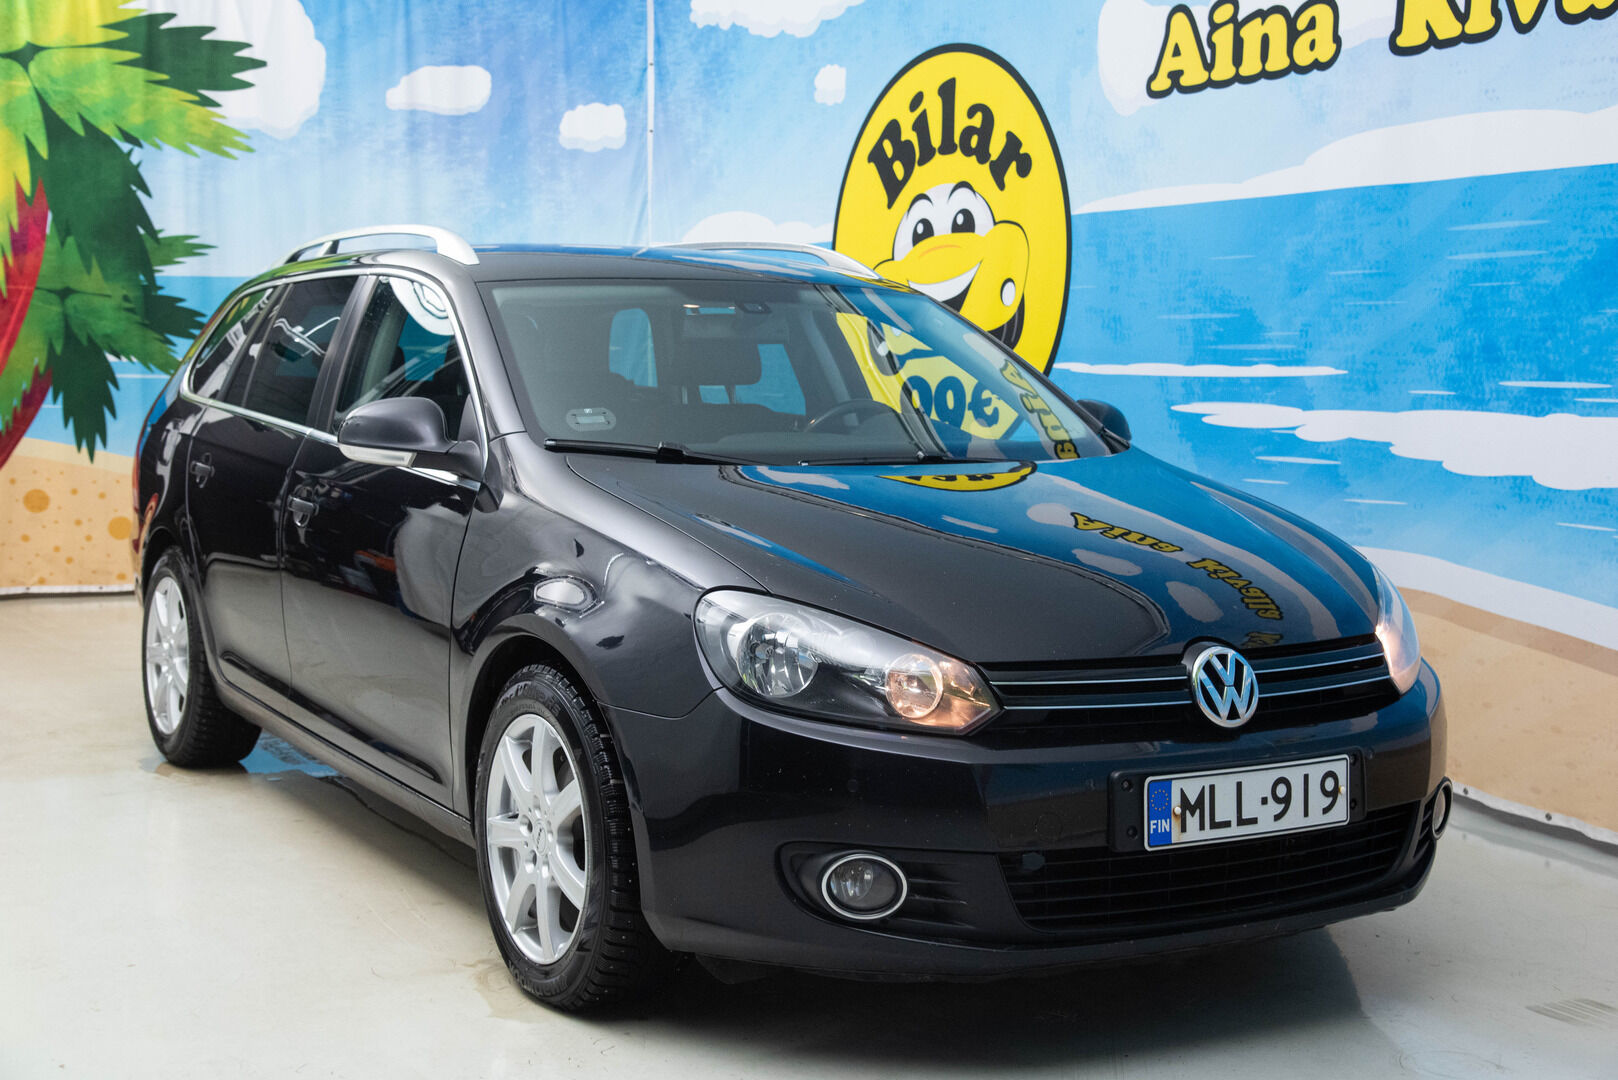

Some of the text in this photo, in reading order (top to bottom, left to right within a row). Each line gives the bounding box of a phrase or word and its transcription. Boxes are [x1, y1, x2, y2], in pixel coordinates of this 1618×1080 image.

[1147, 0, 1342, 98] Aina
[867, 77, 1032, 209] Bilar
[1150, 818, 1170, 834] FIN
[1180, 770, 1340, 833] MLL-919
